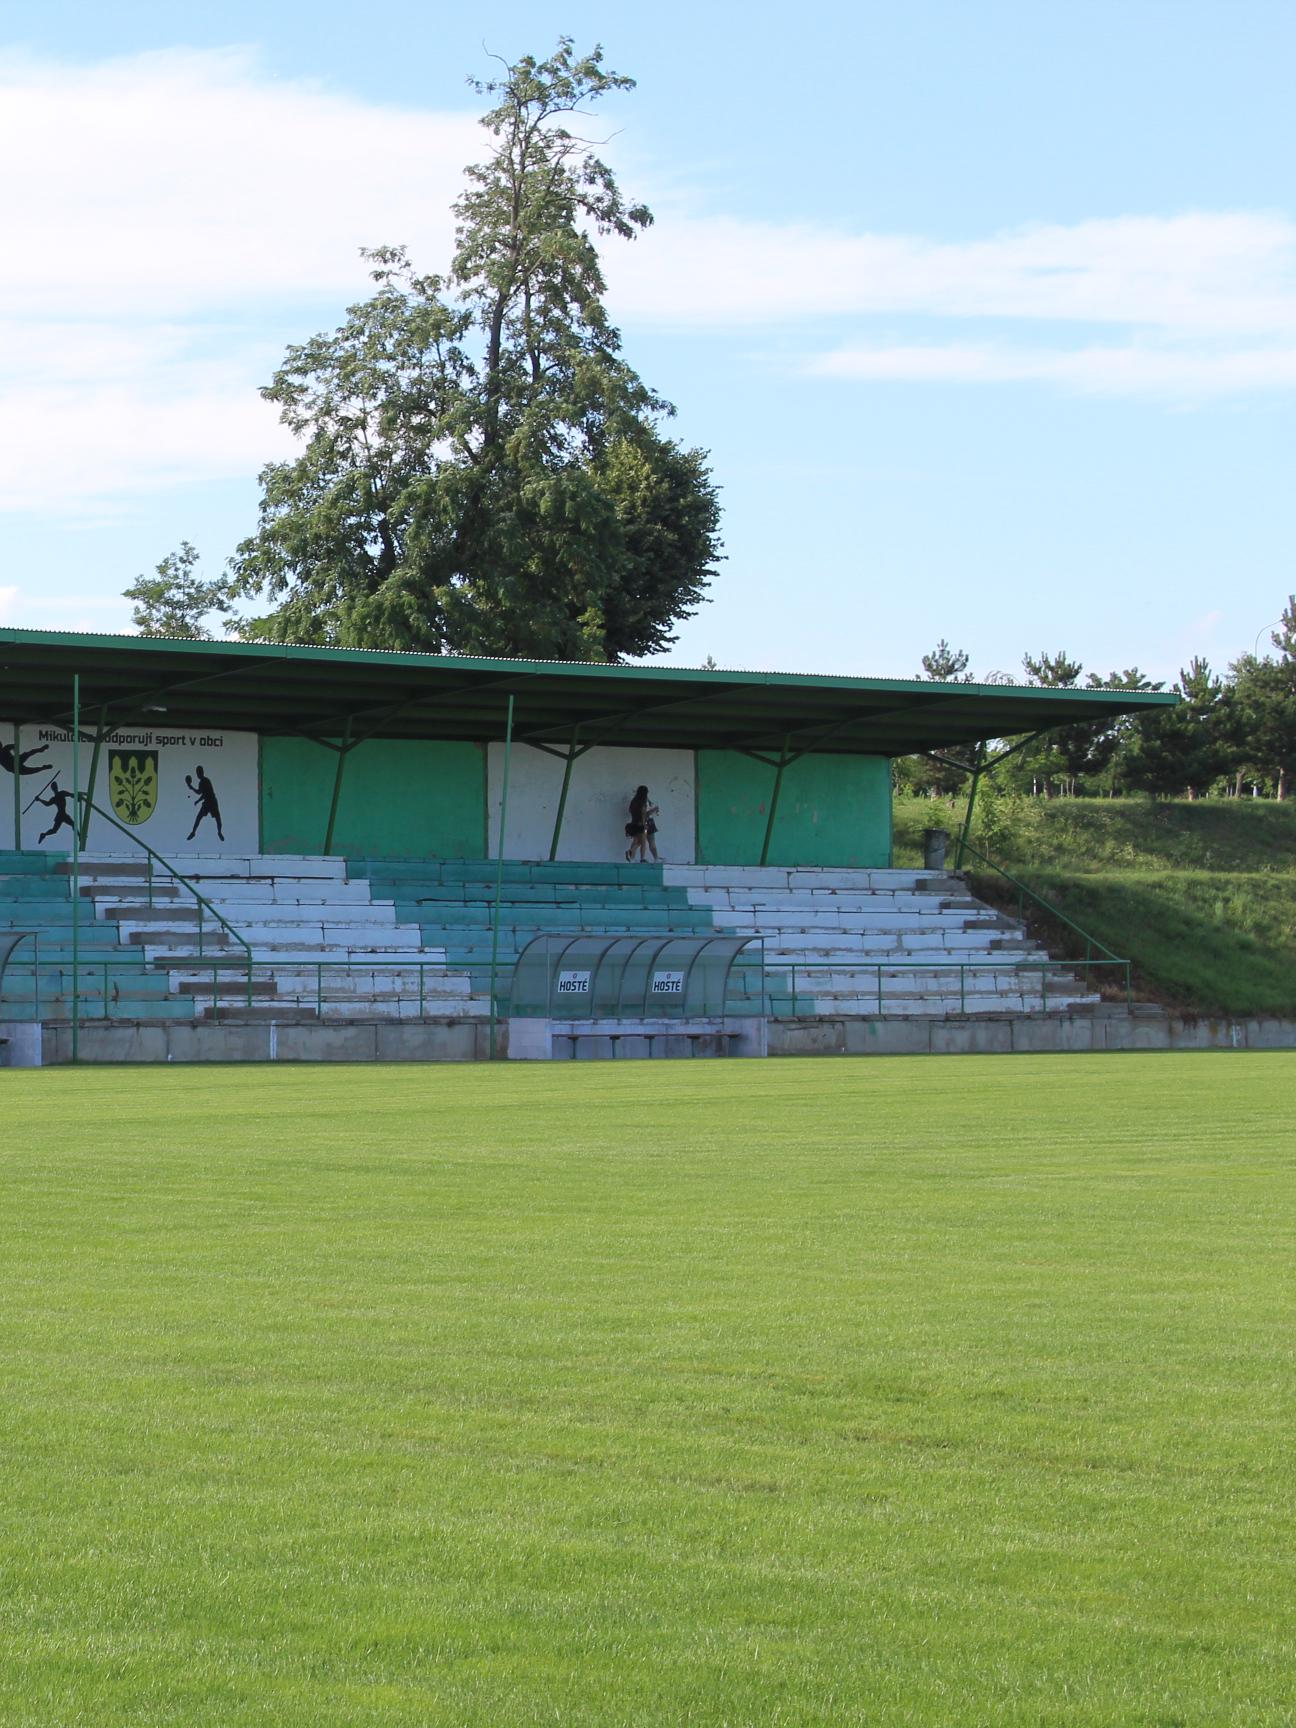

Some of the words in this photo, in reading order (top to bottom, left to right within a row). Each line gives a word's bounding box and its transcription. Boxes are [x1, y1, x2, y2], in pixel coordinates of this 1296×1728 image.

[99, 732, 153, 747] odporují
[155, 735, 186, 747] sport
[189, 737, 197, 746] v
[199, 736, 223, 747] obci
[559, 978, 588, 992] HOSTÉ
[653, 979, 681, 992] HOSTÉ
